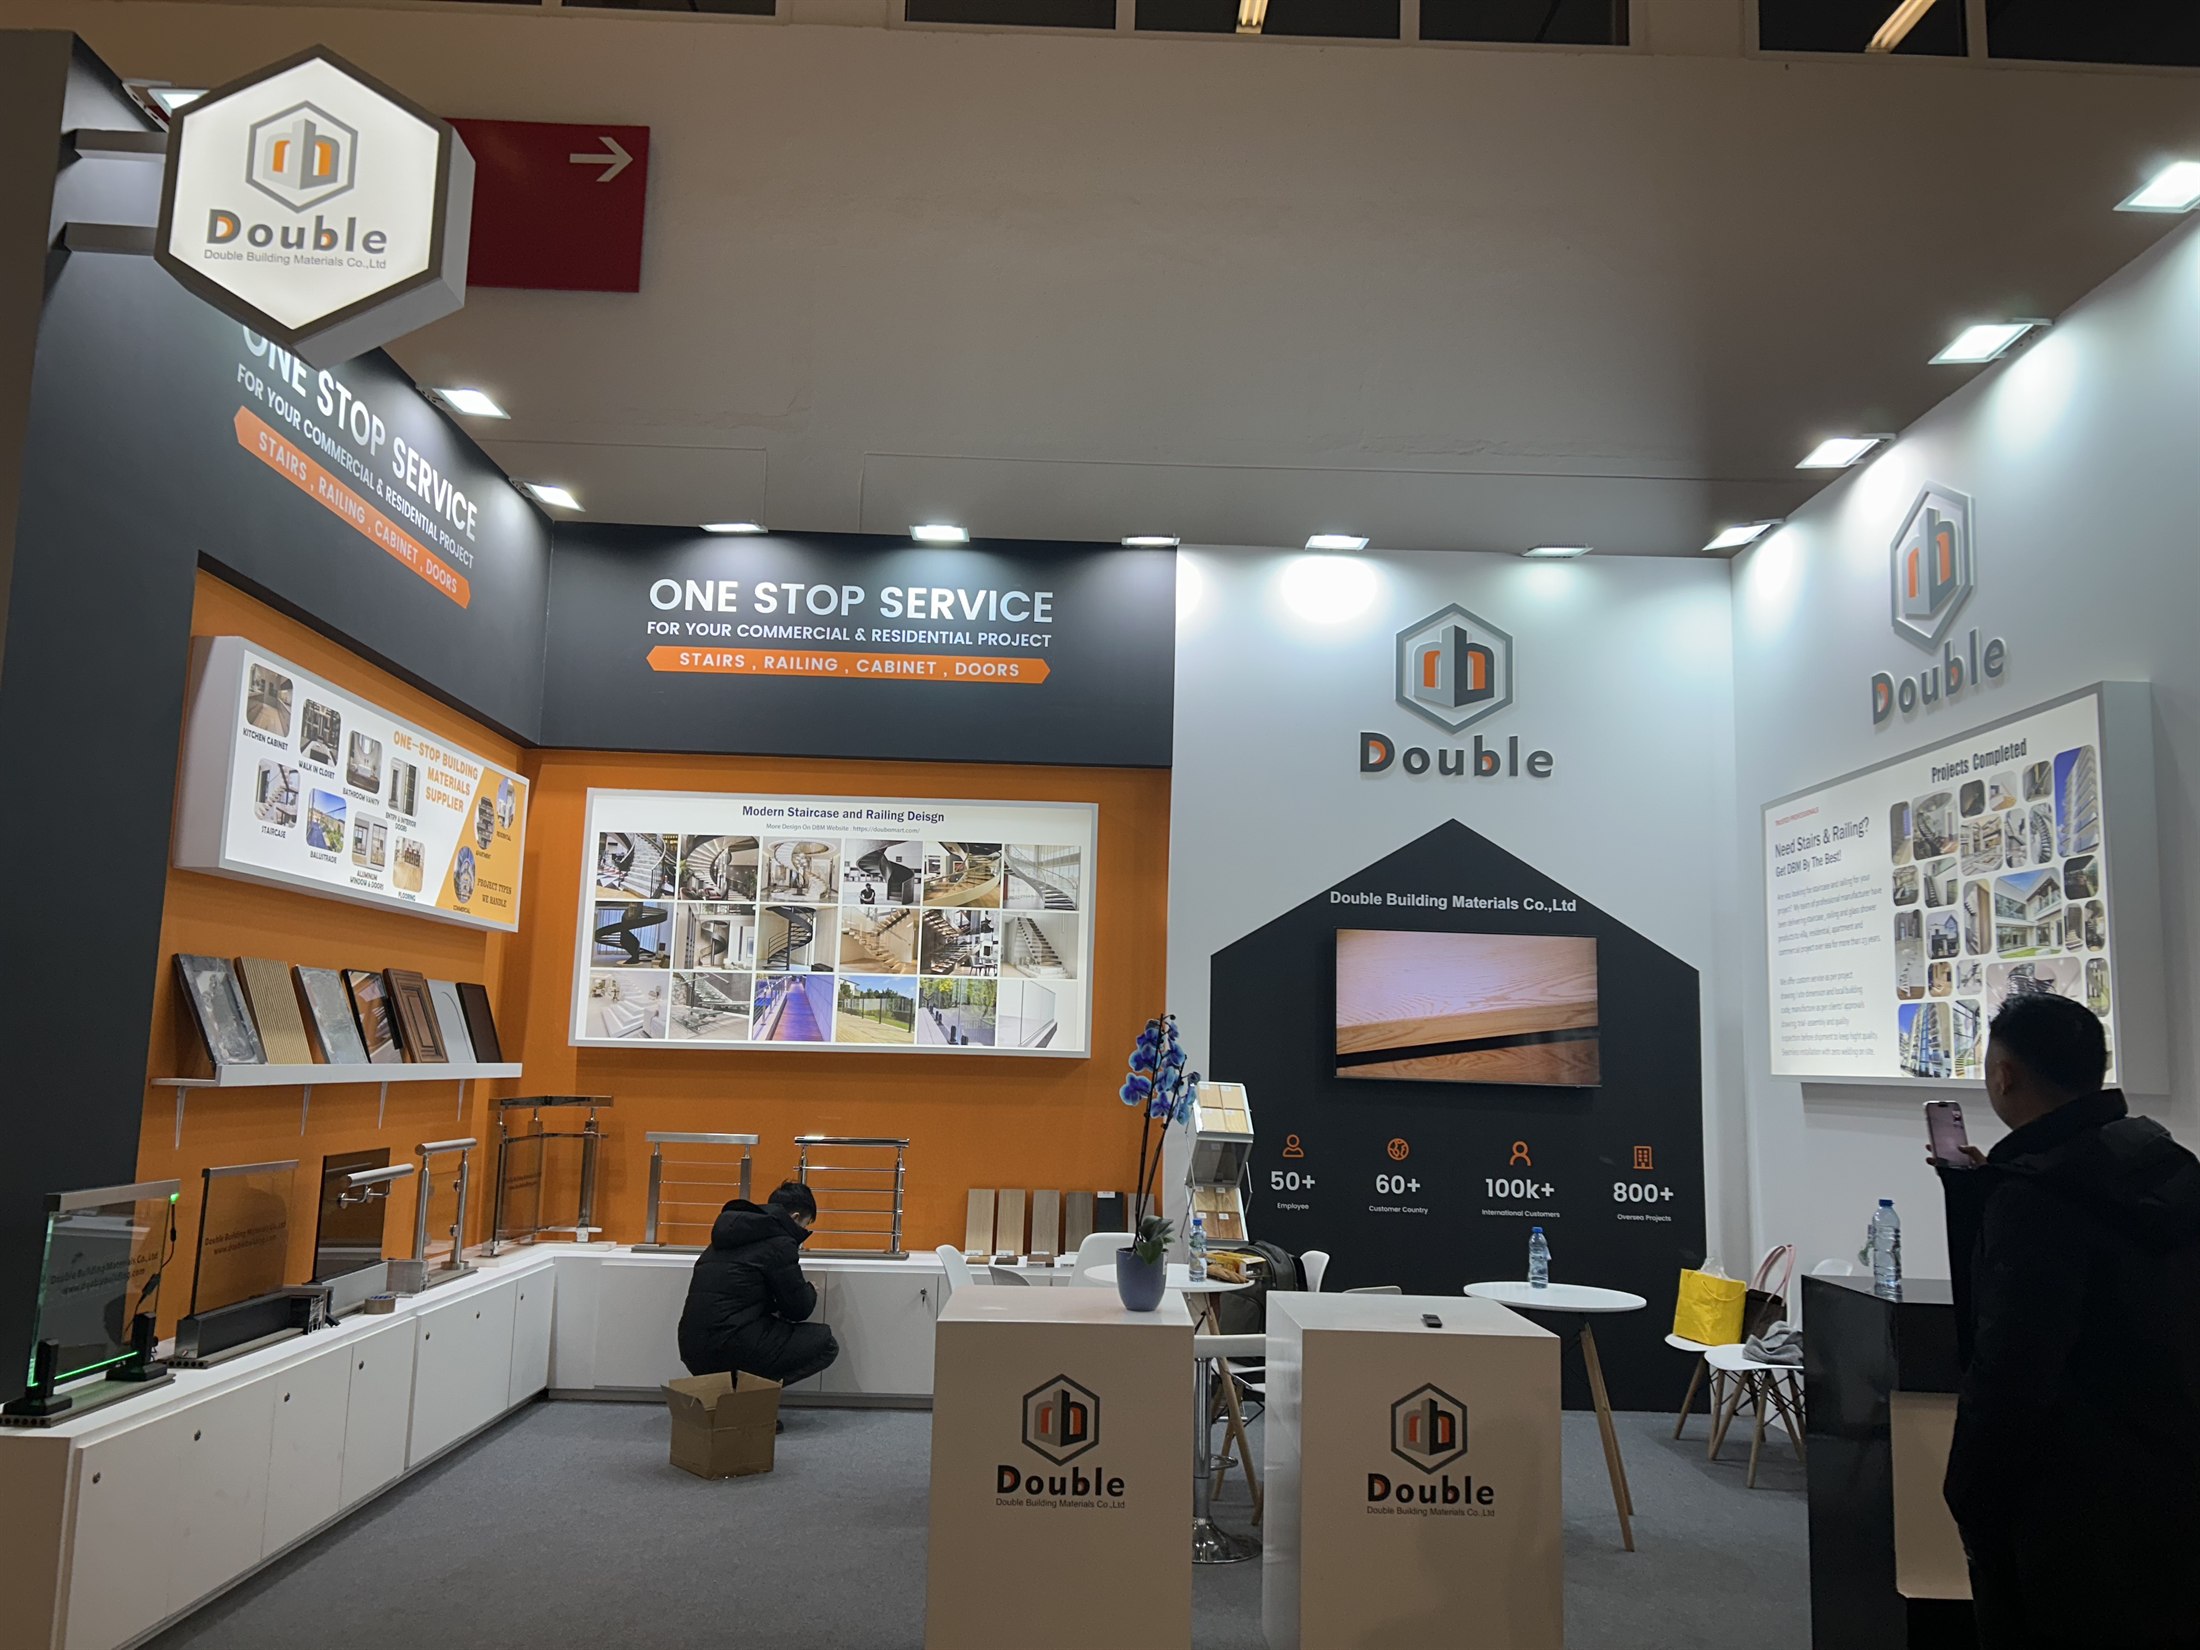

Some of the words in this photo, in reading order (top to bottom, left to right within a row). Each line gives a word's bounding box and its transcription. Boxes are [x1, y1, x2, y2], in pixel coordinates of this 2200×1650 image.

[206, 208, 387, 254] Double
[204, 249, 243, 261] Double
[246, 252, 290, 265] Building
[294, 254, 344, 267] Materials
[347, 258, 386, 269] Co.,Ltd
[243, 324, 307, 397] ONE
[317, 369, 386, 456] STOP
[392, 437, 478, 541] SERVICE
[237, 362, 263, 400] FOR
[267, 386, 301, 431] YOUR
[304, 419, 375, 491] COMMERCIAL
[376, 478, 384, 497] &
[386, 487, 438, 541] RESIDENTIAL
[439, 531, 475, 569] PROJECT
[259, 432, 307, 481] STAIRS
[319, 479, 366, 524] RAILING
[375, 522, 419, 565] CABINET
[425, 560, 457, 593] DOORS
[649, 578, 739, 612] ONE
[753, 581, 866, 616] STOP
[880, 586, 1054, 623] SERVICE
[647, 621, 680, 635] FOR
[685, 622, 732, 637] YOUR
[736, 624, 850, 641] COMMERCIAL
[854, 628, 867, 642] &
[871, 628, 973, 645] RESIDENTIAL
[977, 632, 1052, 647] PROJECT
[679, 652, 745, 667] STAIRS
[764, 656, 838, 671] RAILING
[856, 659, 937, 675] CABINET
[955, 662, 1020, 677] DOORS
[1871, 626, 2006, 725] Double
[243, 727, 267, 743] KITCHEN
[267, 736, 289, 751] CABINET
[442, 753, 478, 780] BUILDING
[1359, 731, 1554, 778] Double
[1931, 759, 1969, 783] Projects
[1973, 738, 2027, 771] Completed
[319, 768, 336, 780] CLOSET
[427, 766, 471, 796] MATERIALS
[425, 786, 464, 813] SUPPLIER
[742, 805, 785, 818] Modern
[787, 807, 840, 819] Staircase
[842, 808, 863, 820] and
[866, 809, 905, 823] Railing
[261, 825, 286, 839] STAIRCASE
[1775, 839, 1796, 858] Need
[1796, 833, 1821, 852] Stairs
[1822, 828, 1831, 844] &
[1832, 816, 1870, 842] Railing?
[1775, 865, 1786, 878] Get
[1802, 859, 1811, 872] By
[1811, 855, 1823, 868] The
[1330, 891, 1382, 905] Double
[1386, 893, 1448, 910] Building
[1452, 895, 1519, 910] Materials
[1523, 898, 1577, 912] Co.,Ltd
[1270, 1170, 1315, 1191] 50+
[1375, 1174, 1421, 1194] 60+
[1485, 1178, 1555, 1199] 100k+
[1613, 1182, 1674, 1203] 800+
[1277, 1202, 1309, 1211] Employee
[1368, 1205, 1401, 1213] Customer
[1402, 1206, 1428, 1215] Country
[1481, 1209, 1524, 1217] International
[1524, 1210, 1560, 1218] Customers
[1617, 1213, 1644, 1221] Oversea
[1645, 1214, 1672, 1222] Projects
[997, 1464, 1125, 1497] Double
[1367, 1473, 1495, 1505] Double
[995, 1498, 1024, 1506] Double
[1025, 1499, 1057, 1509] Building
[1059, 1499, 1095, 1508] Materials
[1367, 1506, 1395, 1515] Double
[1396, 1507, 1428, 1517] Building
[1429, 1508, 1465, 1516] Materials
